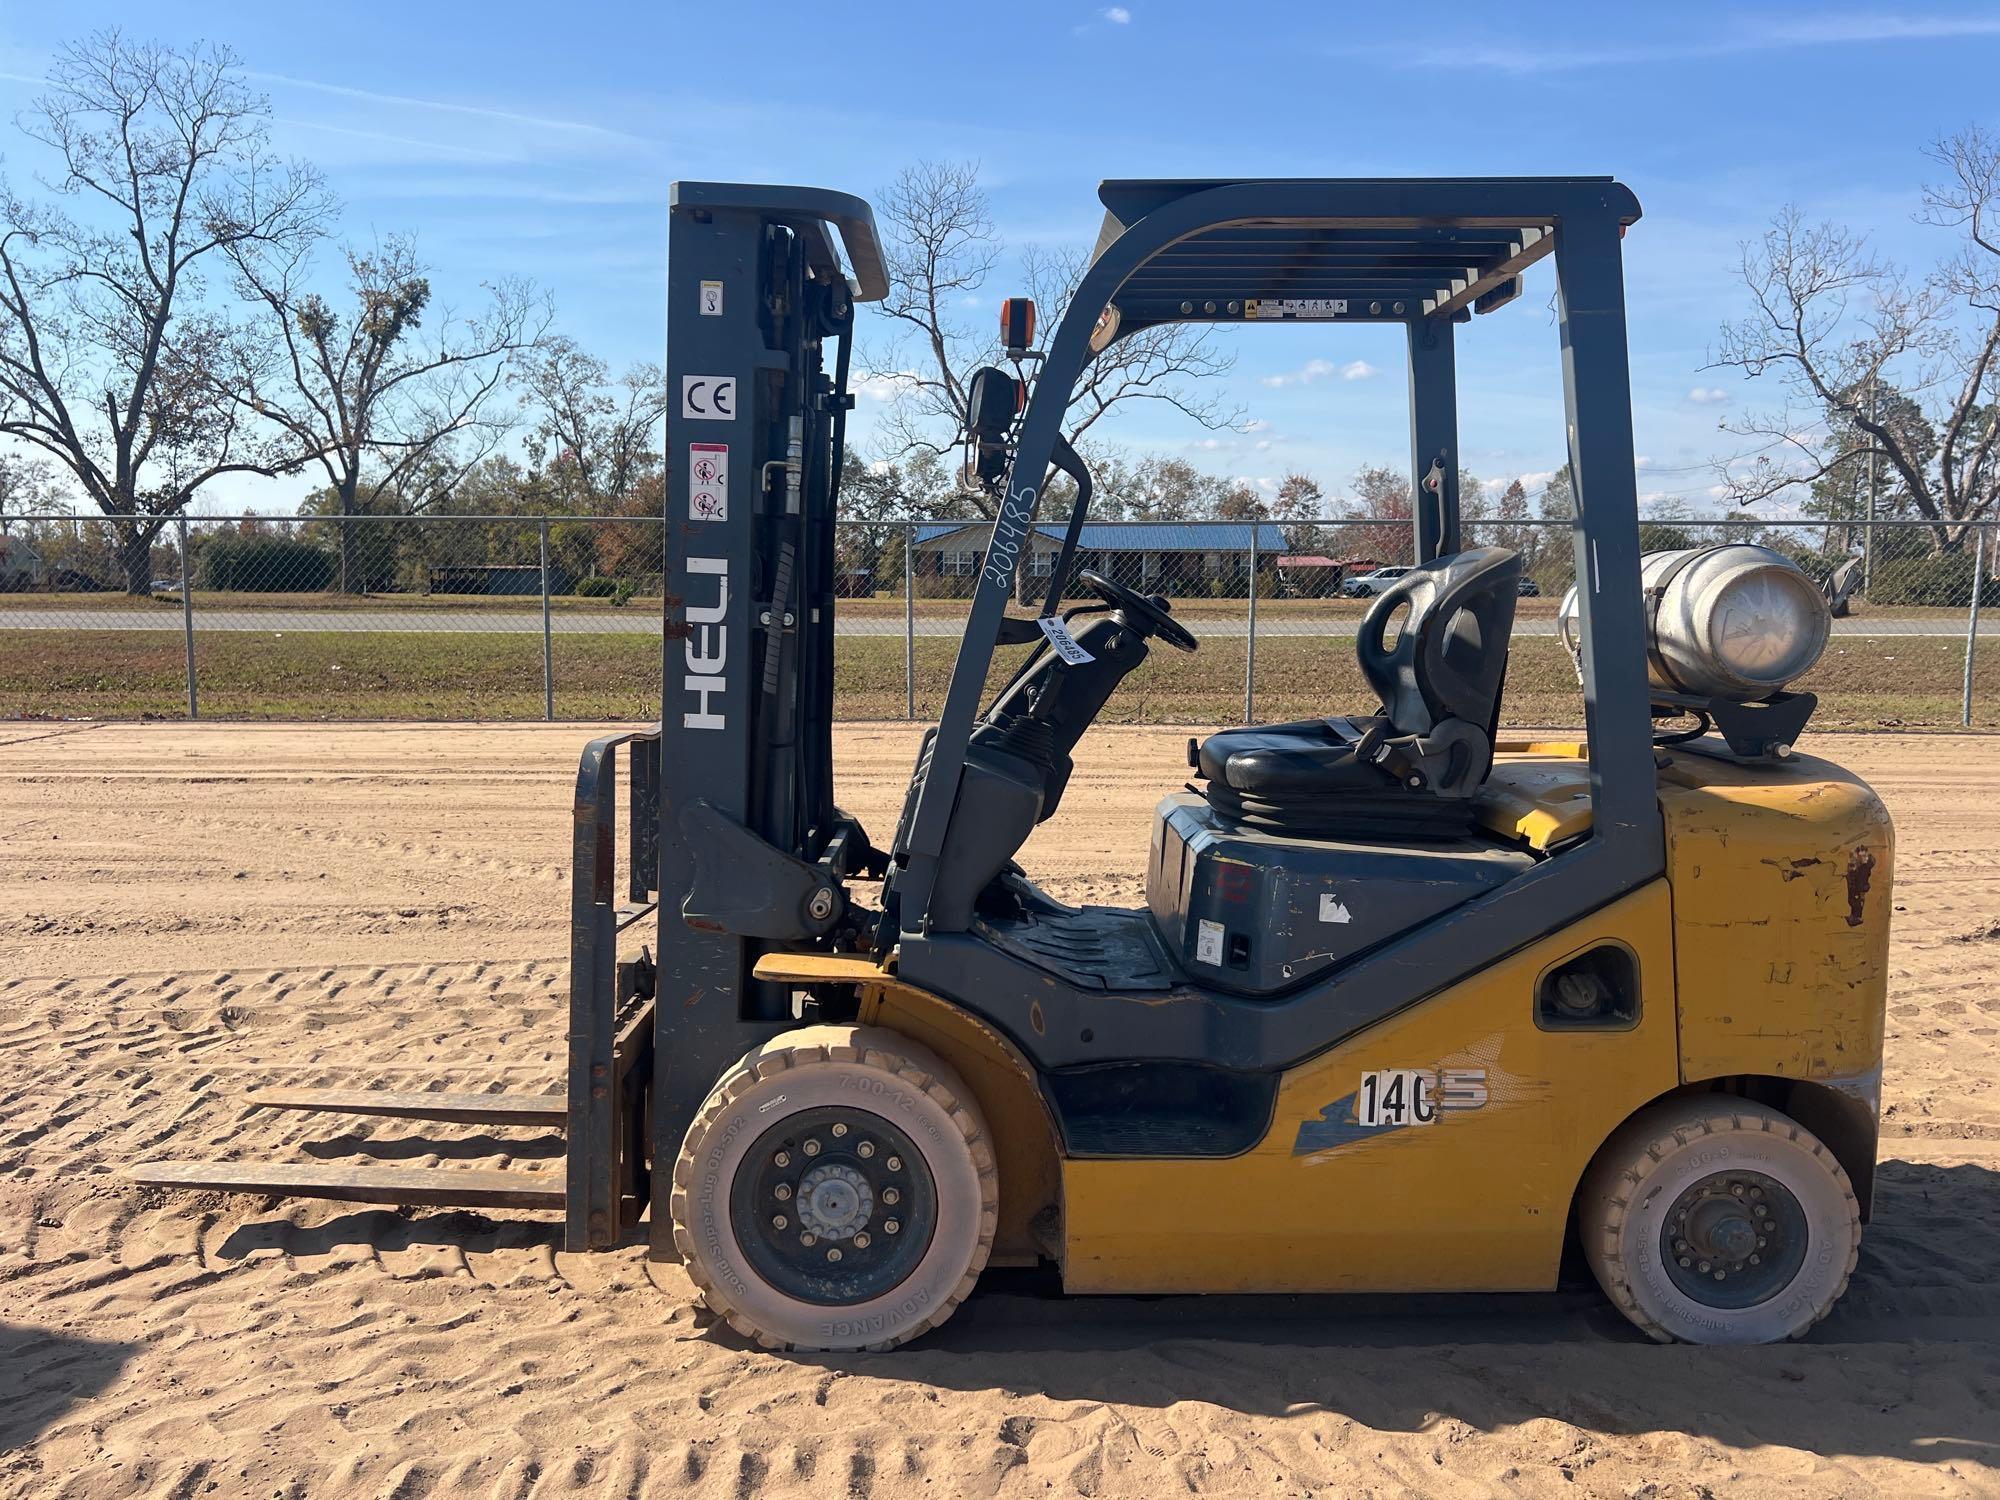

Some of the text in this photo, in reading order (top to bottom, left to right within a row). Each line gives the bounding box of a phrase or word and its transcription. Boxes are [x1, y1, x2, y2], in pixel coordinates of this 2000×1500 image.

[688, 382, 730, 414] CE
[984, 481, 1036, 588] 206485
[684, 557, 728, 730] HELI
[1052, 629, 1085, 659] 206485
[839, 1073, 916, 1113] 7.00-12
[702, 1170, 748, 1297] Solid-Super-Lug
[821, 1287, 930, 1337] ADVANCE
